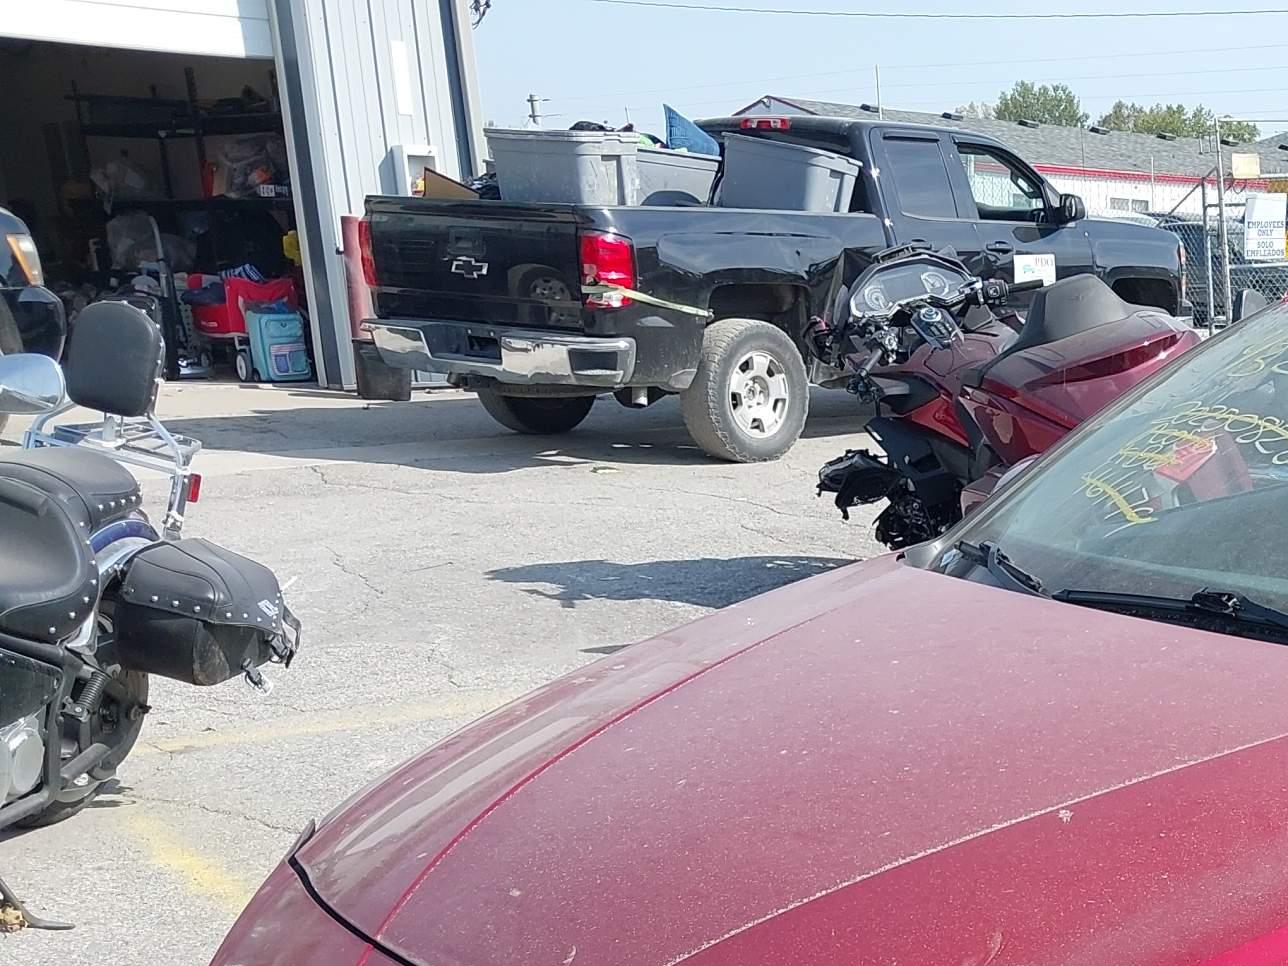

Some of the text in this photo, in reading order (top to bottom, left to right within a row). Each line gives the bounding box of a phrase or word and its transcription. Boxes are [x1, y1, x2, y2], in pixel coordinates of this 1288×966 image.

[1247, 221, 1284, 229] EMPLOYEES
[1257, 240, 1274, 249] SOLO
[1246, 249, 1285, 257] EMPLEADOS
